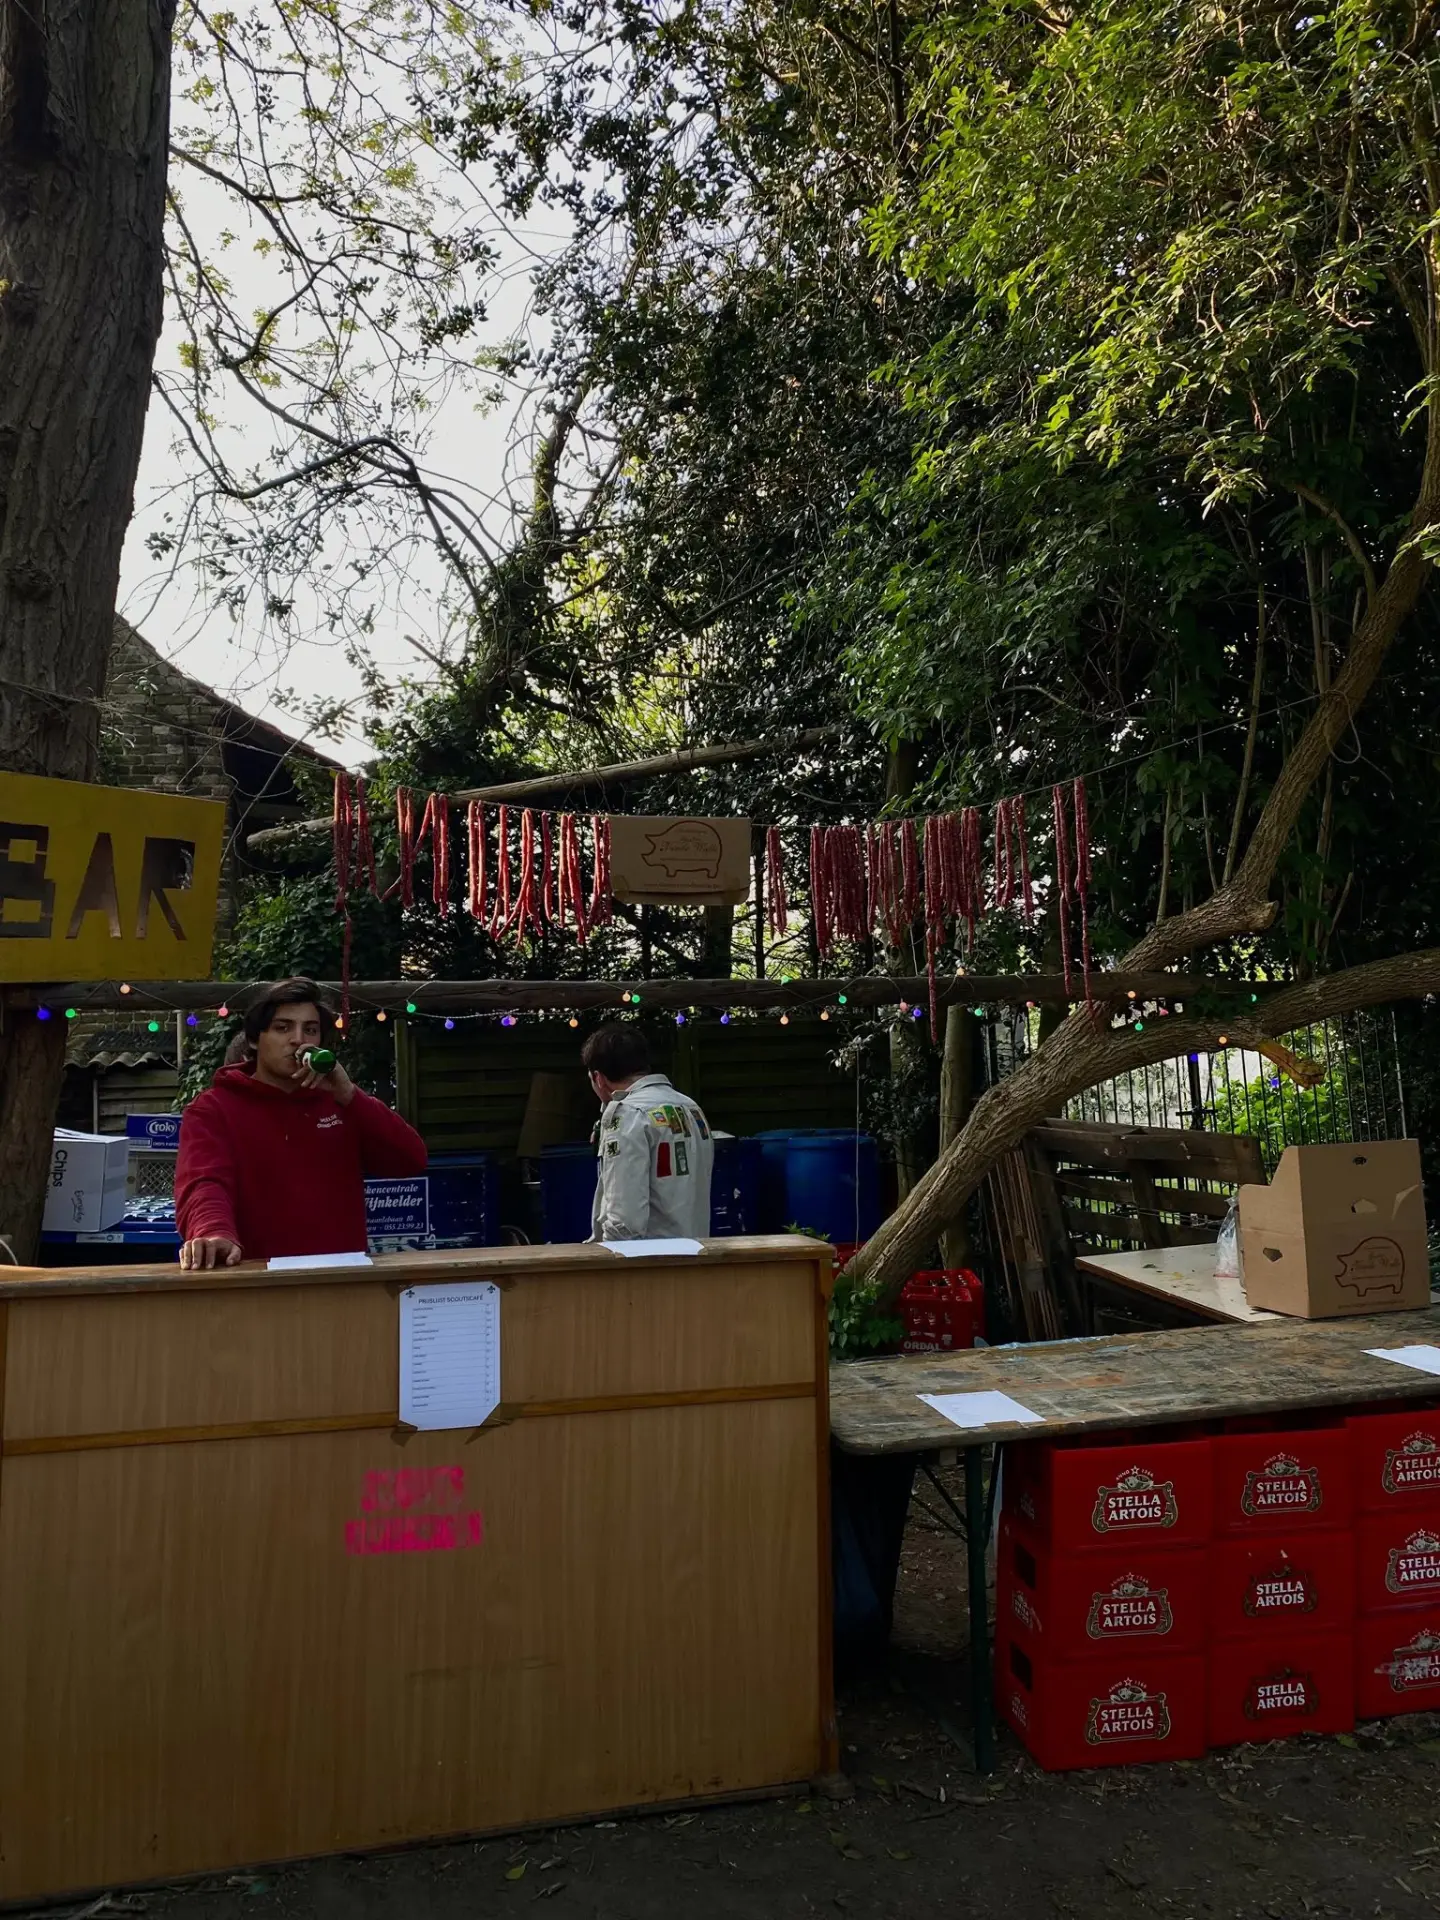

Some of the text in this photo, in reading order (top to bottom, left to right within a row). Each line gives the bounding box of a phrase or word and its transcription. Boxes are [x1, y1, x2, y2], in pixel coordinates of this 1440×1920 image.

[0, 811, 196, 941] BAR
[149, 1121, 175, 1134] Croky
[52, 1149, 68, 1187] Chips
[364, 1184, 419, 1195] kencentrale
[1396, 1468, 1440, 1482] ARTOI
[1256, 1480, 1307, 1493] STELLA
[1108, 1494, 1161, 1509] STELLA
[1256, 1491, 1307, 1505] ARTOIS
[1108, 1507, 1162, 1521] ARTOIS
[1399, 1556, 1440, 1570] STELL
[1256, 1581, 1304, 1595] STELLA
[1255, 1592, 1305, 1608] ARTOIS
[1102, 1601, 1156, 1615] STELLA
[1103, 1613, 1156, 1628] ARTOIS
[1257, 1682, 1305, 1698] STELLA
[1256, 1694, 1306, 1710] ARTOIS
[1101, 1705, 1154, 1721] STELLA
[1100, 1718, 1154, 1733] ARTOIS
